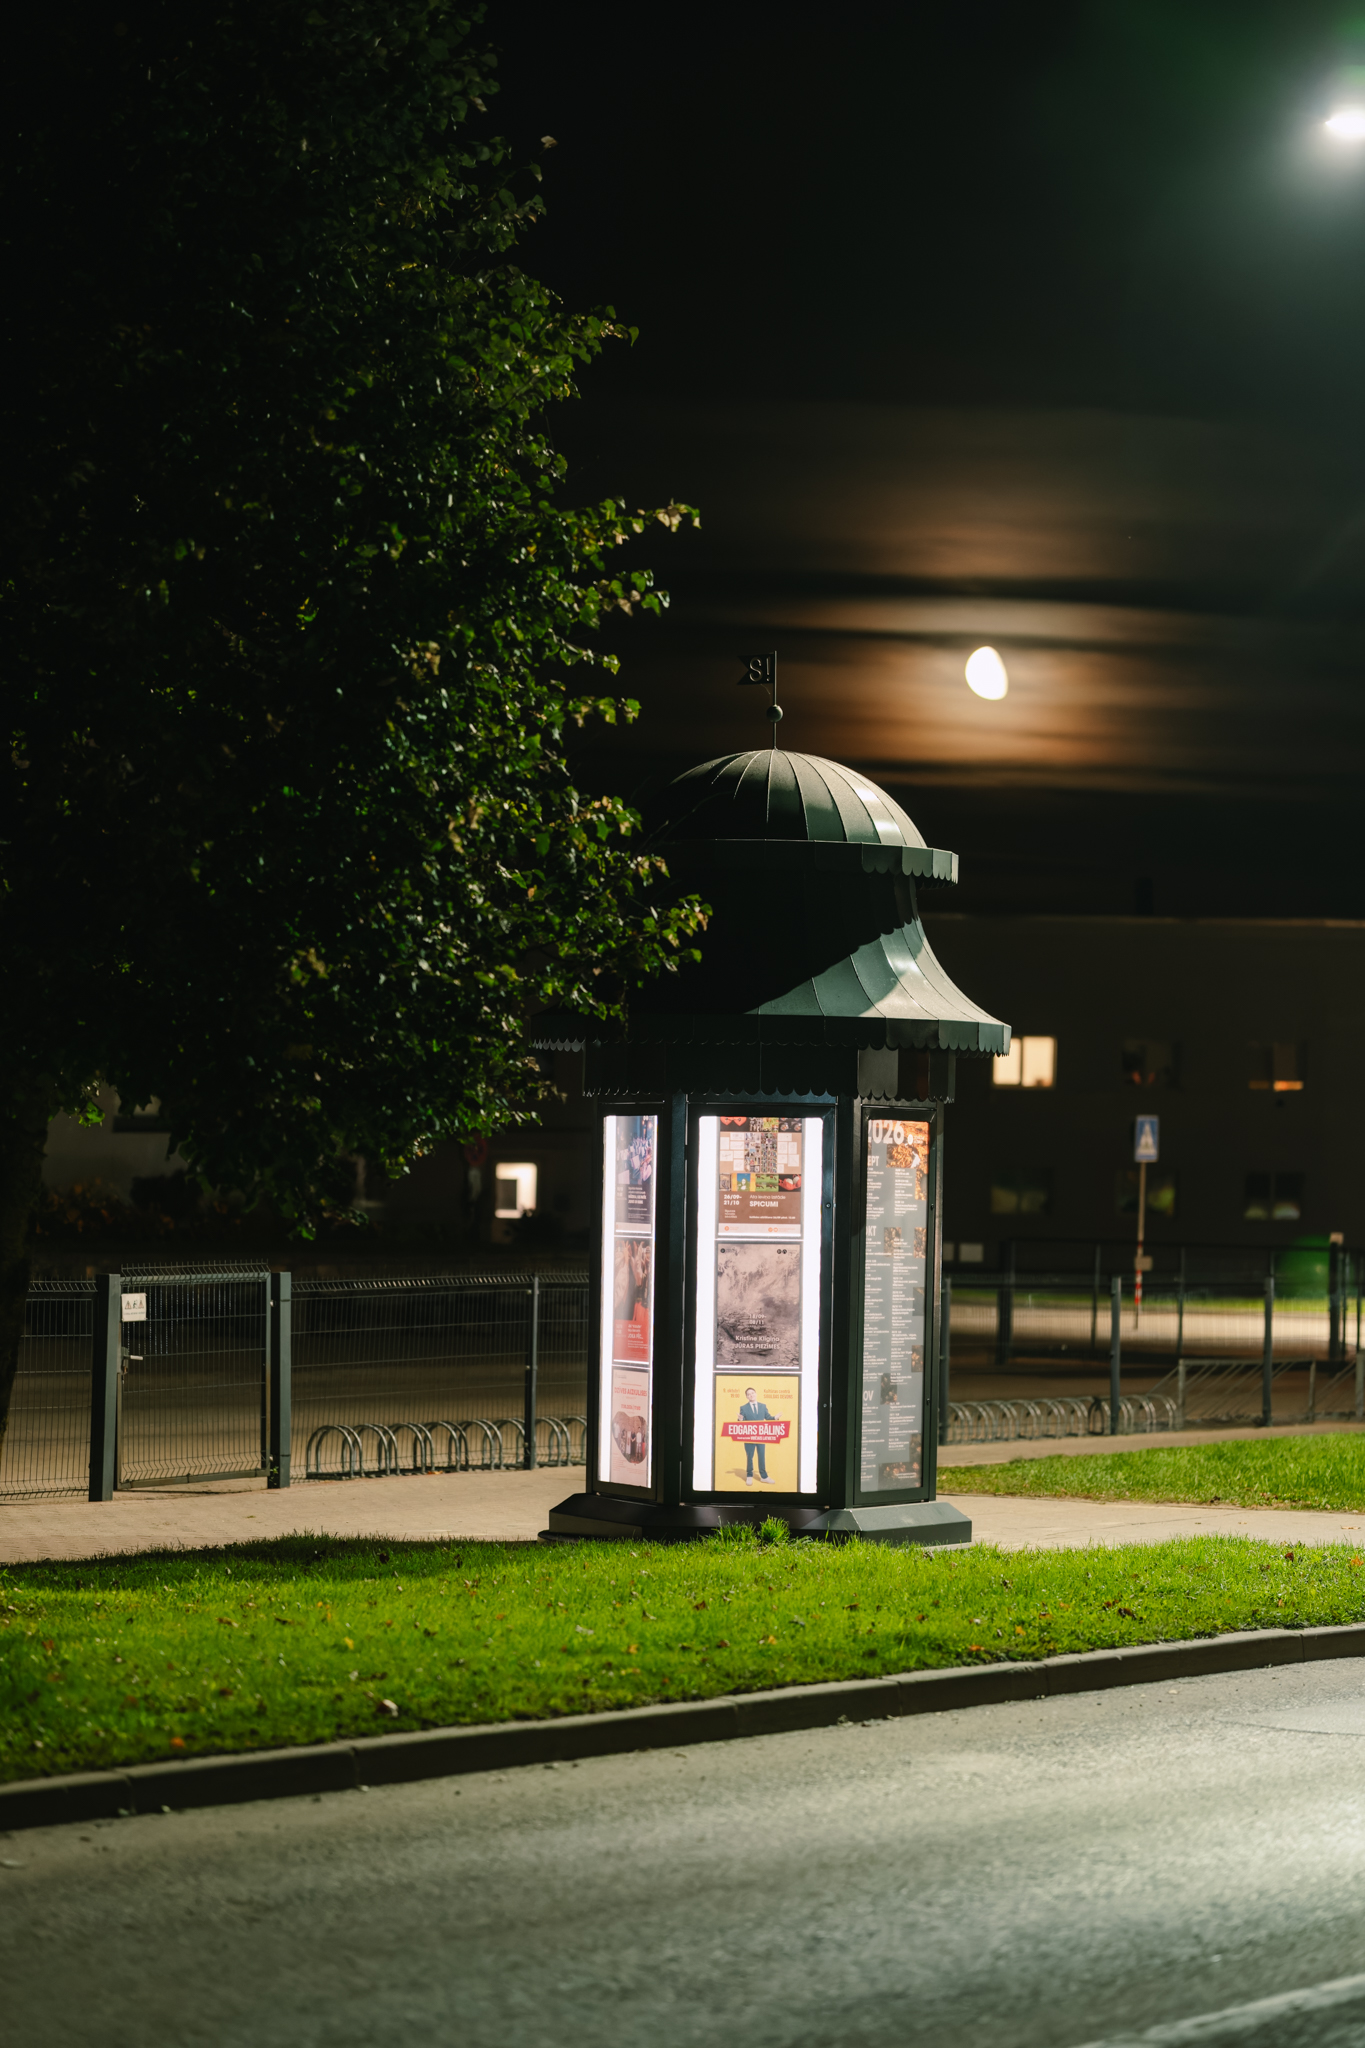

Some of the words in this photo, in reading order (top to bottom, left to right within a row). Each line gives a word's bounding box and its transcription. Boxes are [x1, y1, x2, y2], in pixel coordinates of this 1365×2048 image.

[749, 1200, 779, 1208] SPICUMI
[728, 1424, 758, 1435] EDGARS
[758, 1423, 785, 1438] BĀLIŅŠ
